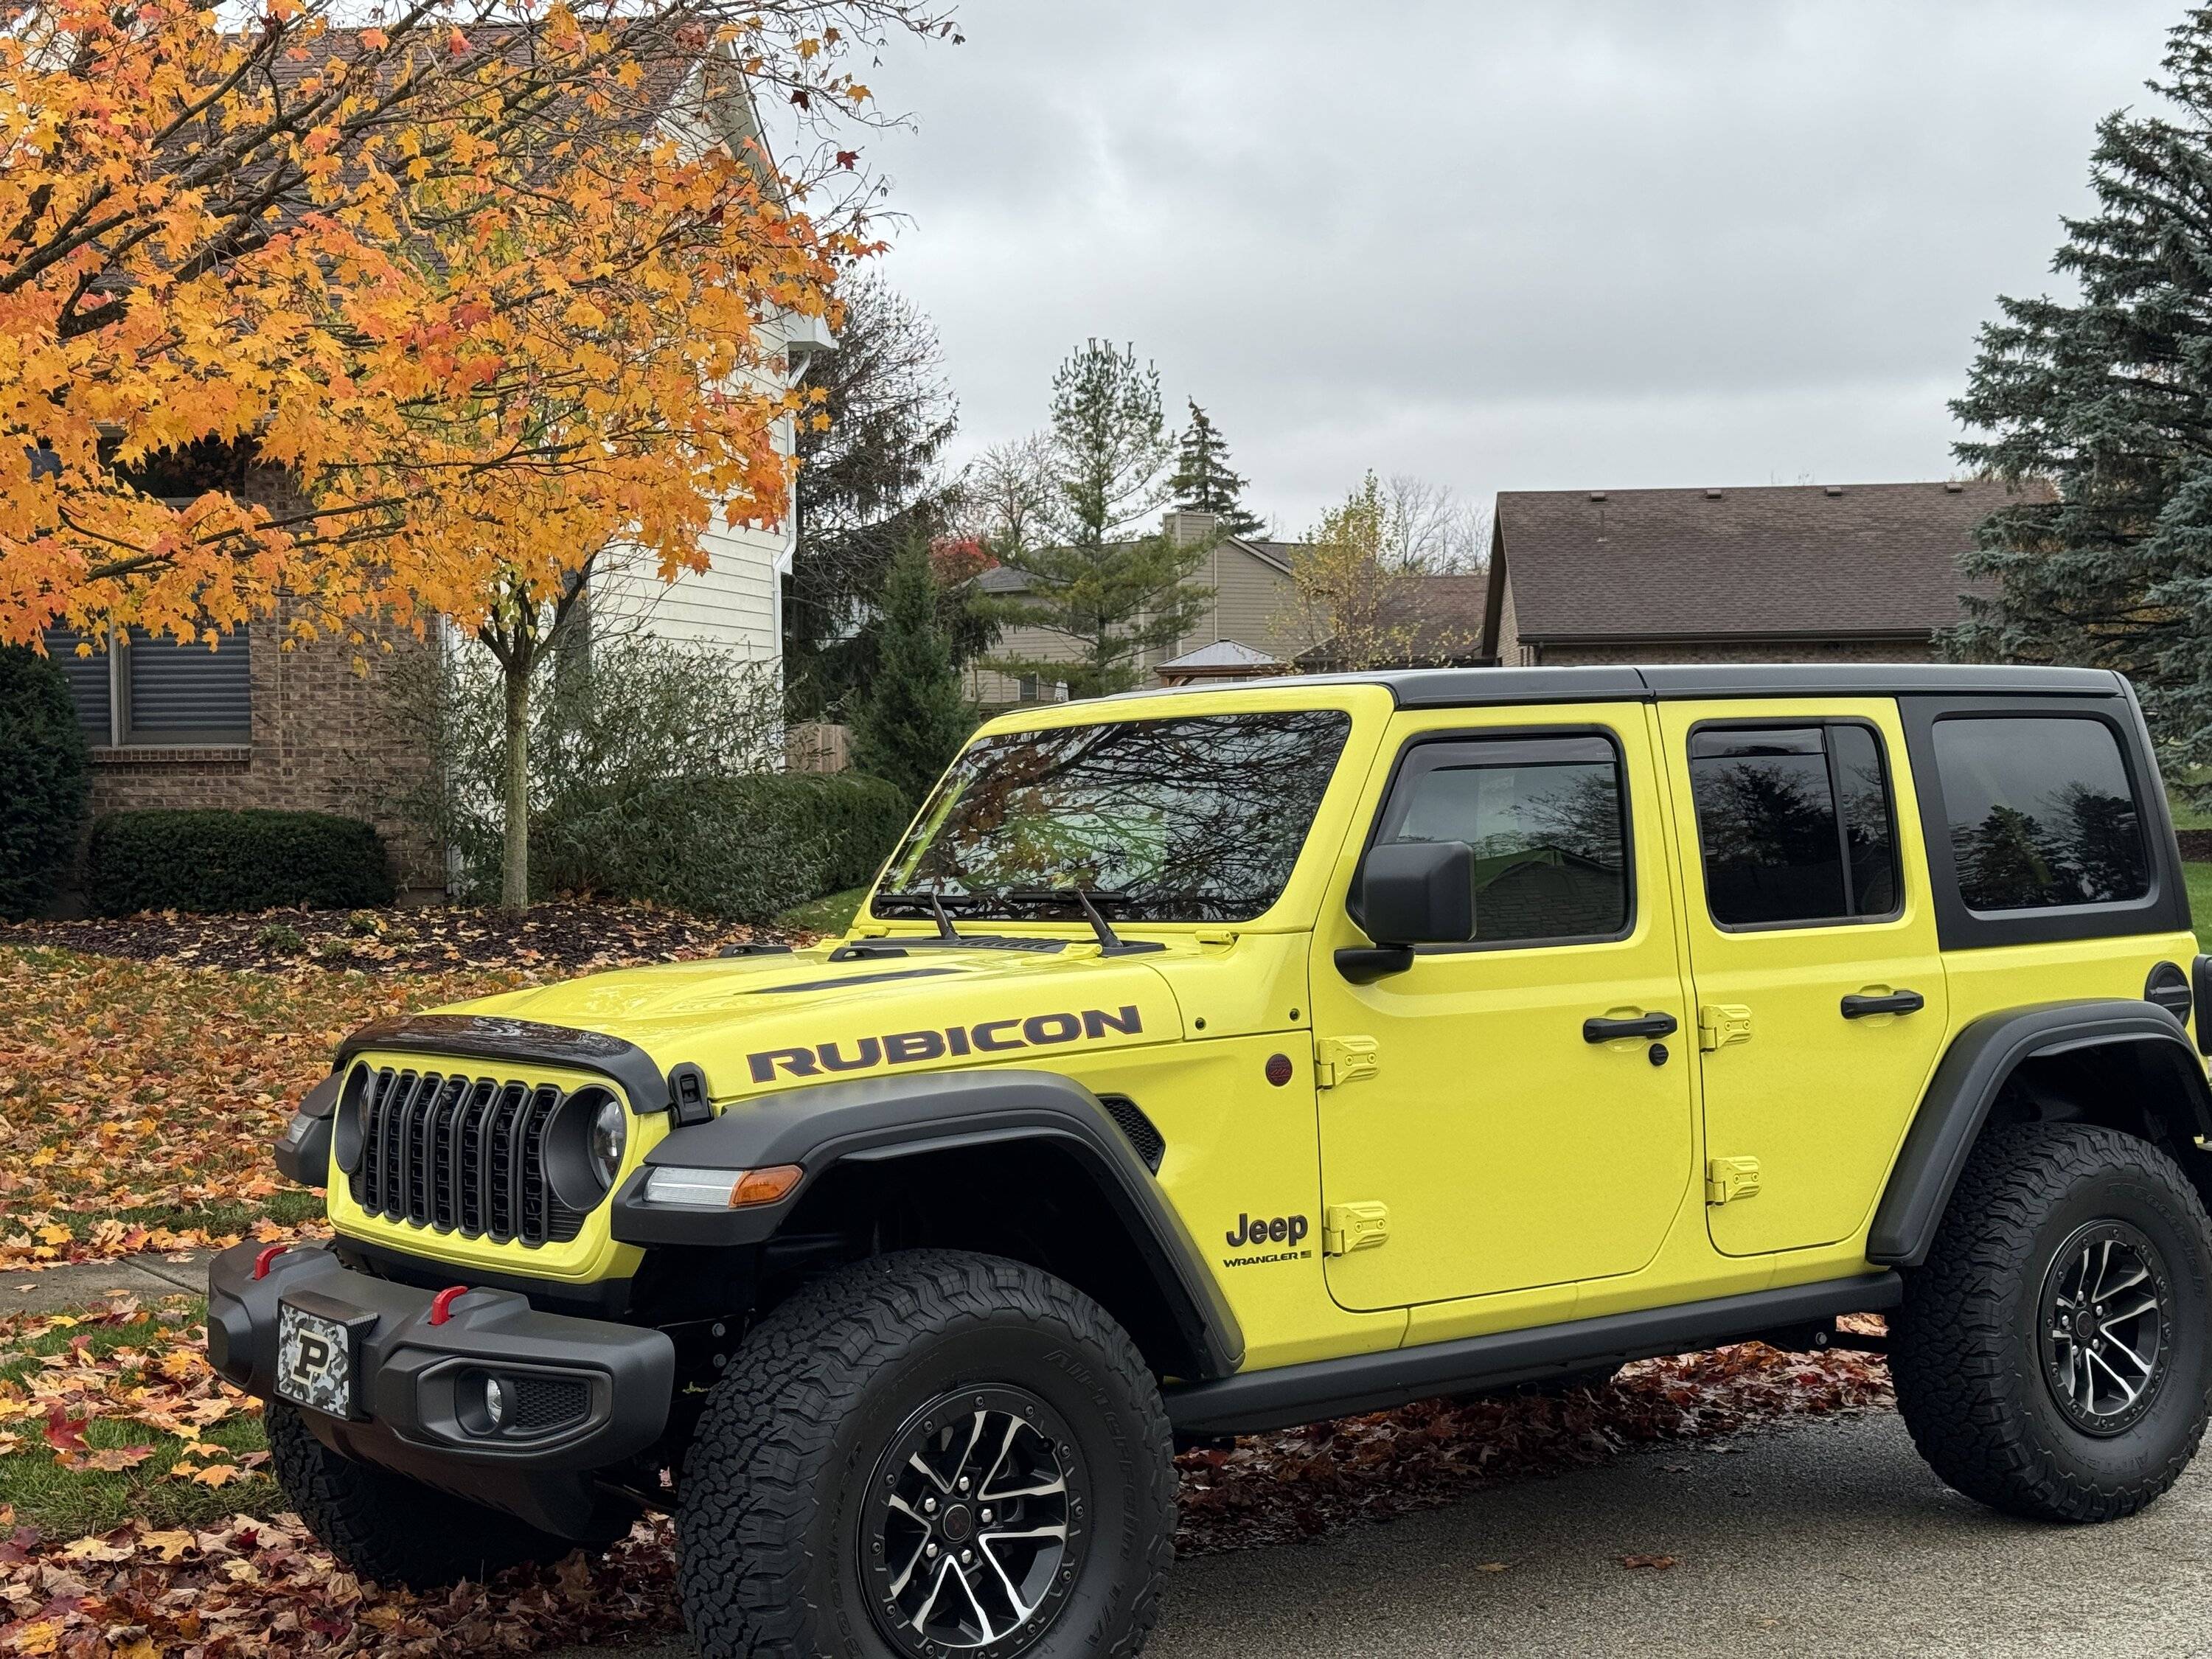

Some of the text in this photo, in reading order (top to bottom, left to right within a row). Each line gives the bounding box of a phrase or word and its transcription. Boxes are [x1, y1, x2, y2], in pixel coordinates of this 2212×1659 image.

[746, 1005, 1143, 1083] RUBICON
[1226, 1213, 1308, 1247] Jeep
[1223, 1252, 1299, 1267] WRANGLER
[291, 1328, 331, 1385] P
